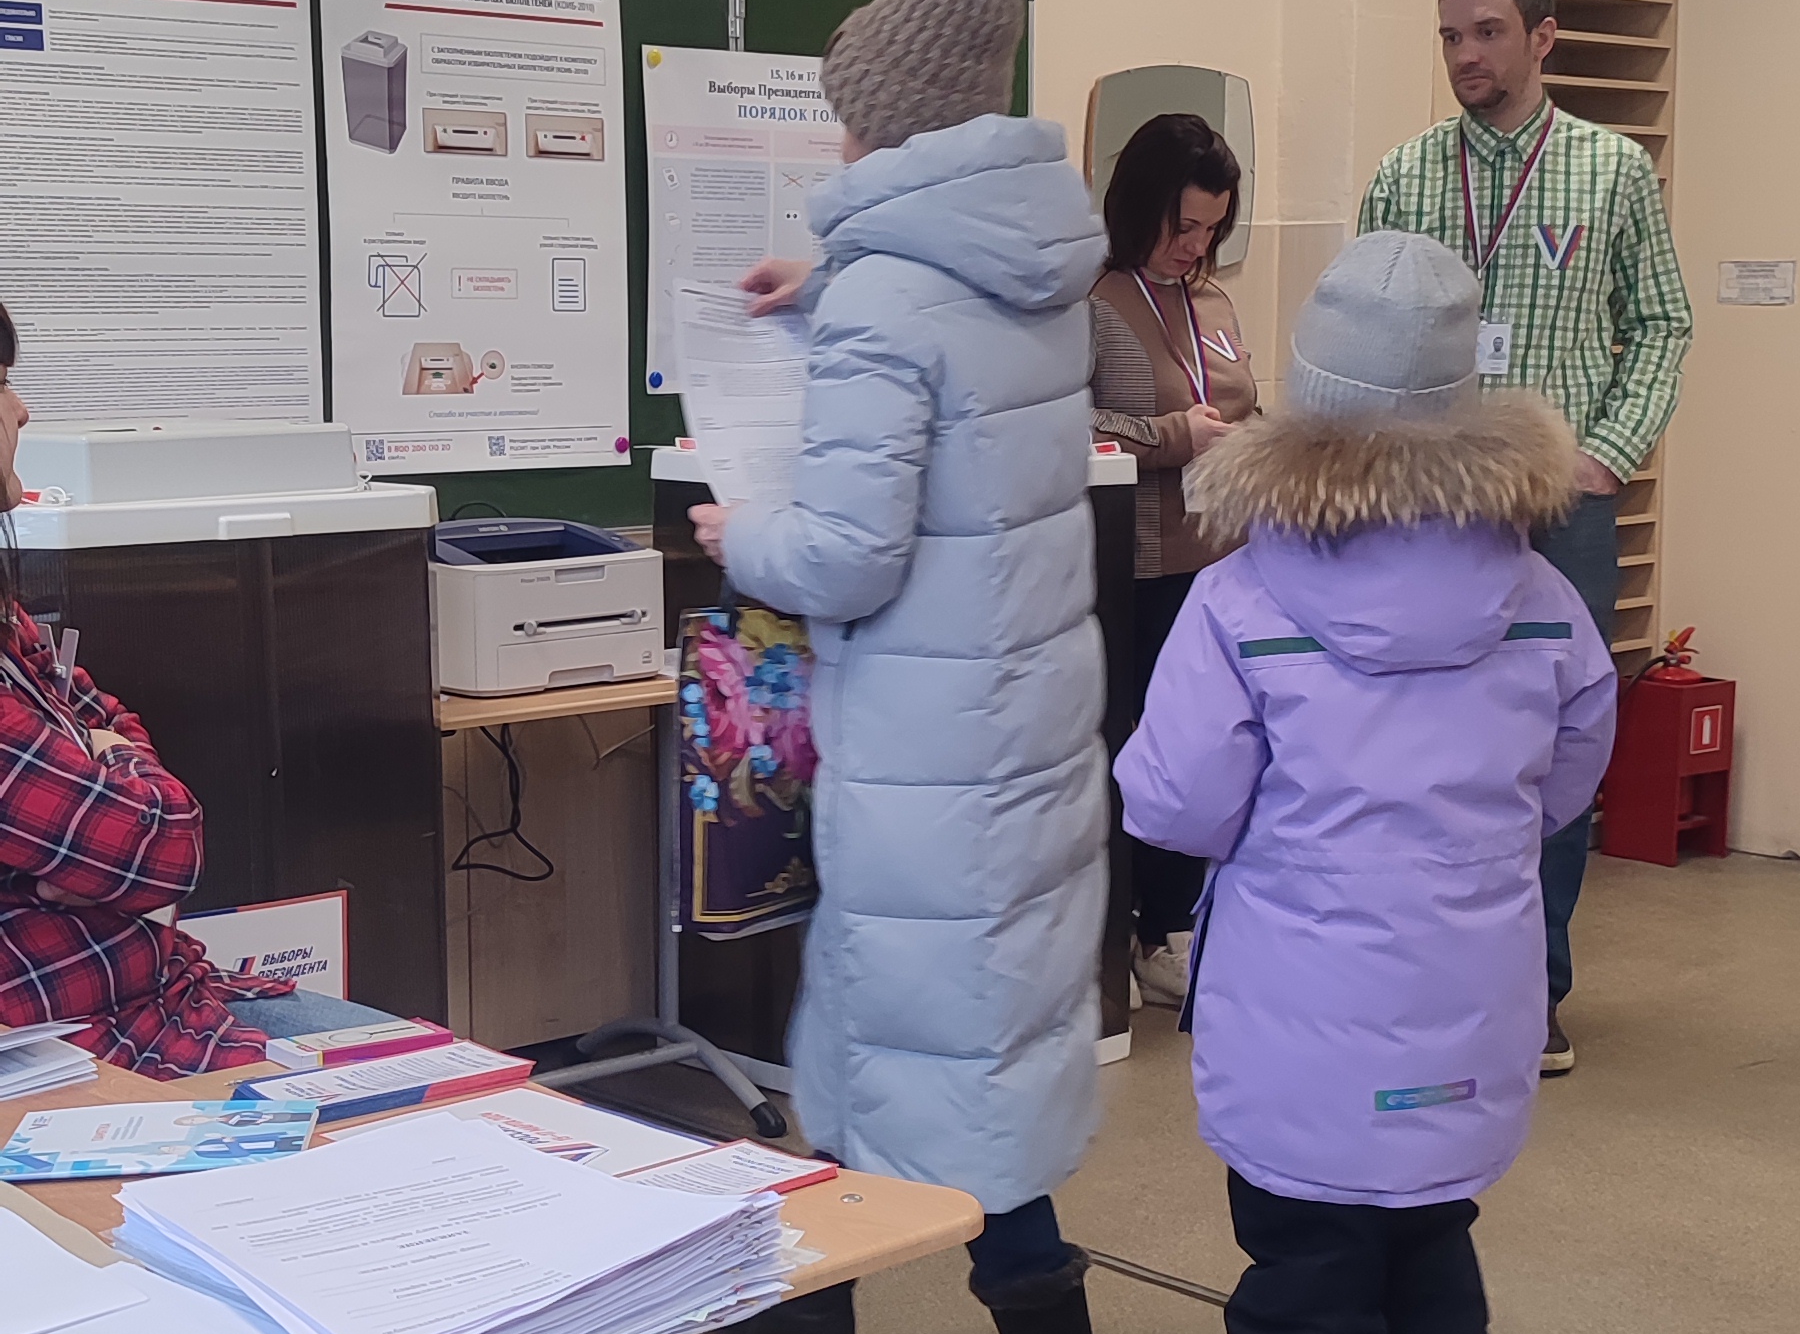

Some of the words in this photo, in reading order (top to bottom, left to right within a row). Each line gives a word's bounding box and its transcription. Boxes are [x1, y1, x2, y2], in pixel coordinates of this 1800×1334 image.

[770, 69, 783, 81] 15,
[785, 70, 796, 80] 16
[797, 73, 804, 81] и
[806, 72, 816, 81] 17
[708, 80, 756, 99] Выборы
[758, 84, 822, 100] Президента
[737, 105, 808, 122] ПОРЯДОК
[812, 109, 839, 123] ГОЛ
[261, 945, 314, 966] ВЫБОРЫ
[258, 959, 328, 979] ПРЕЗИДЕНТА
